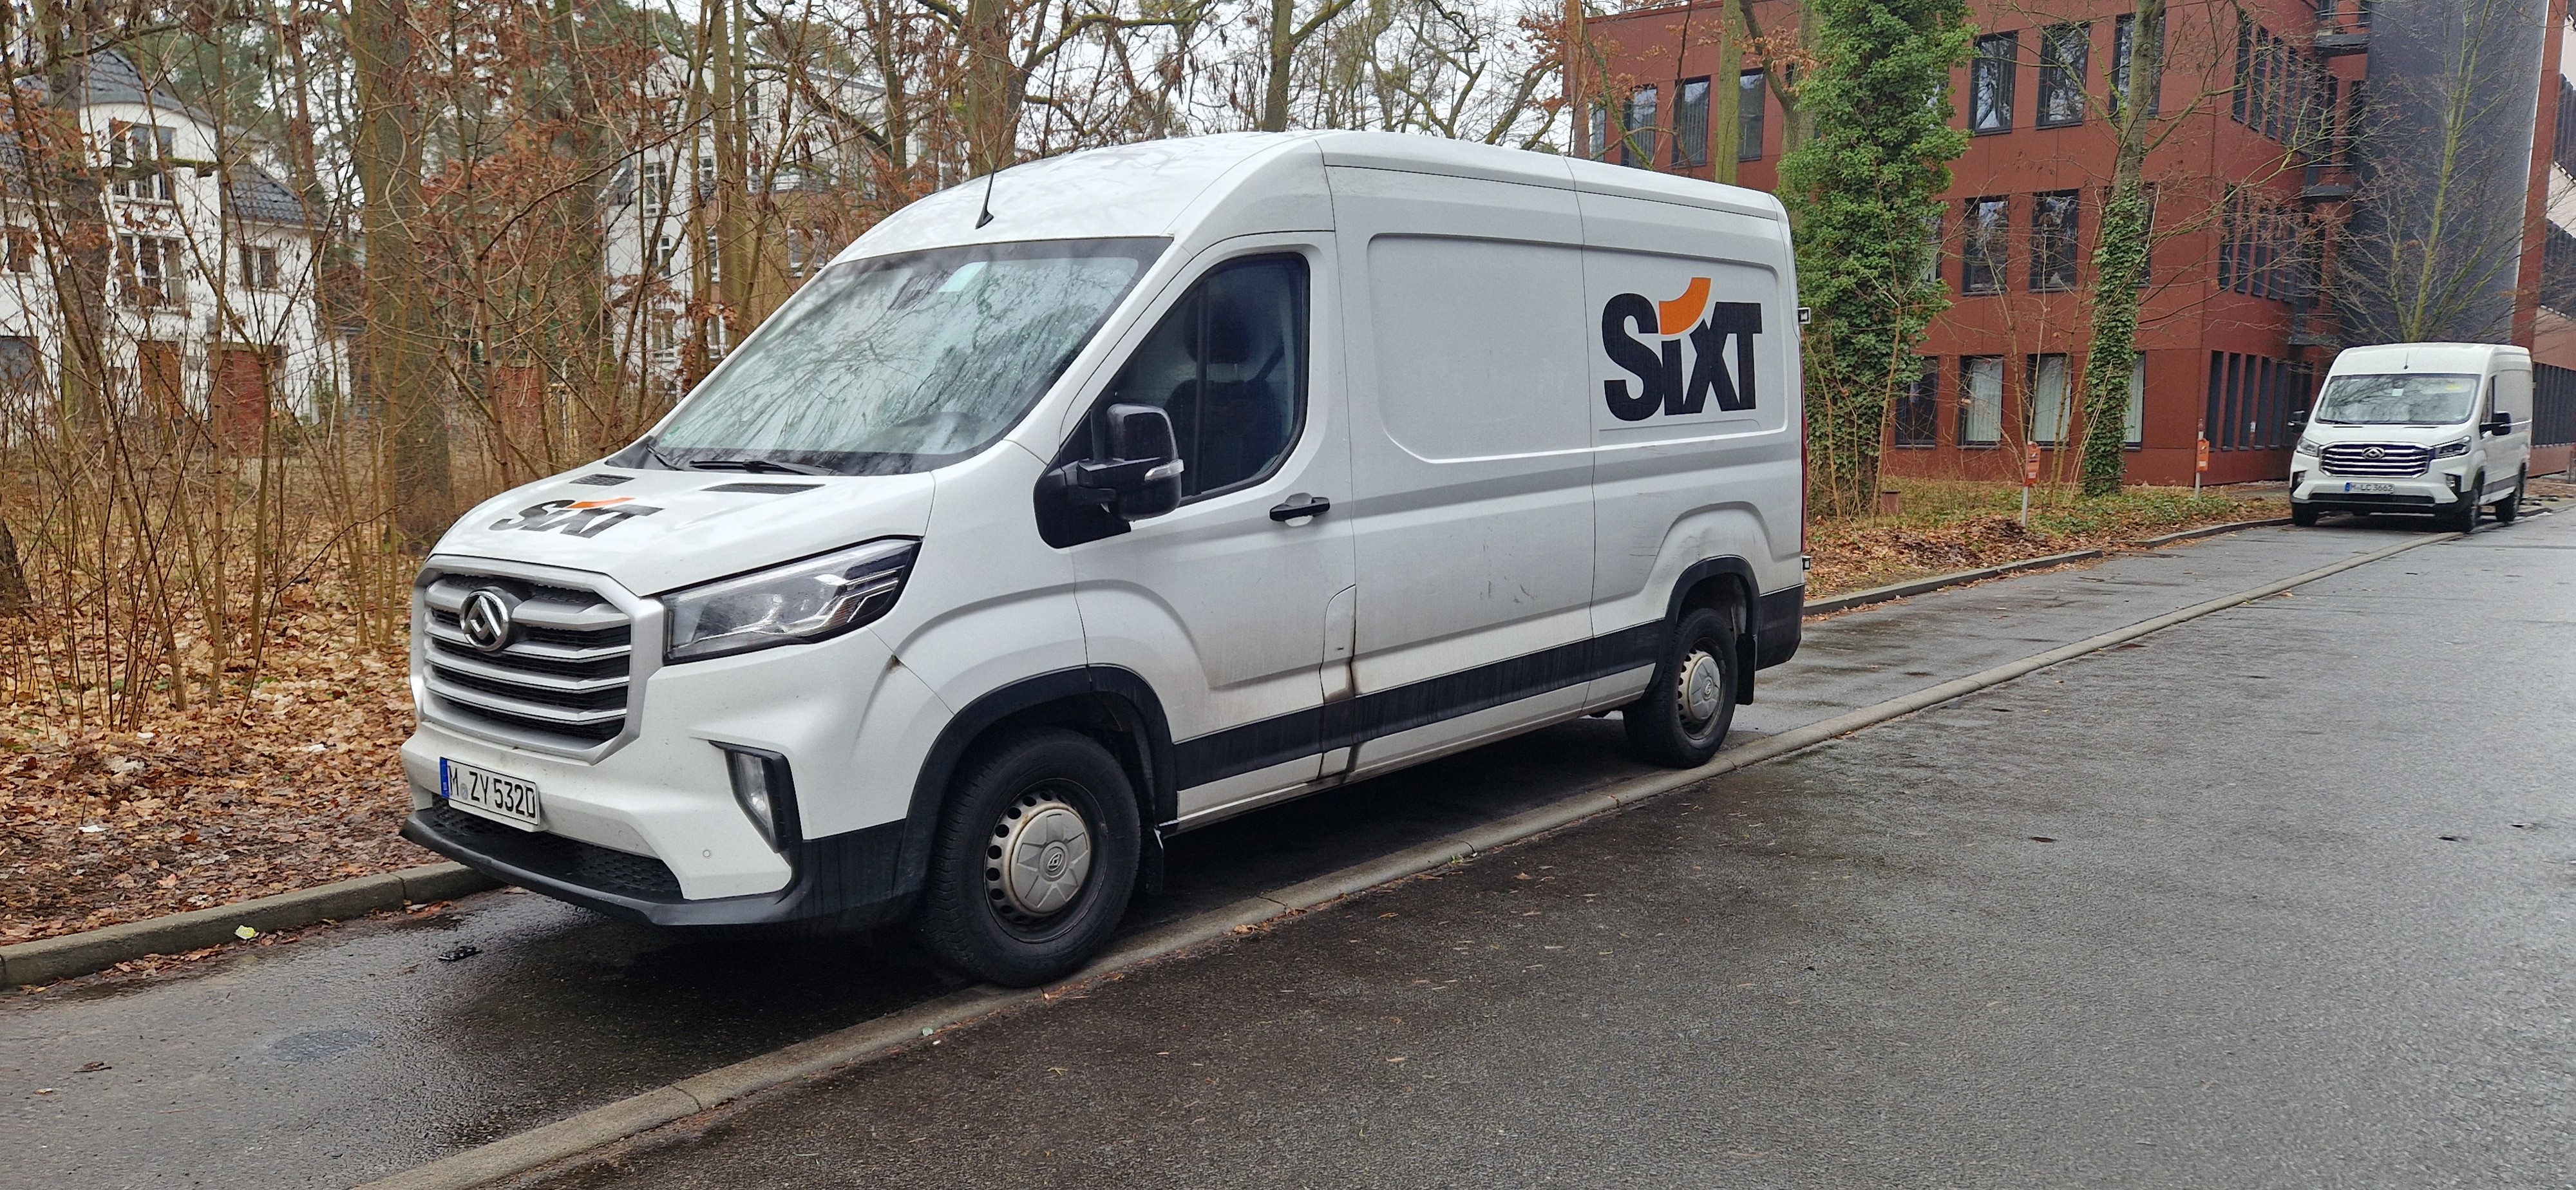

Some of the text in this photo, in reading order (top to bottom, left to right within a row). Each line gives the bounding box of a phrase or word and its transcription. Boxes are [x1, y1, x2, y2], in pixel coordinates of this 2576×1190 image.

[448, 765, 536, 818] M ZY 5320
